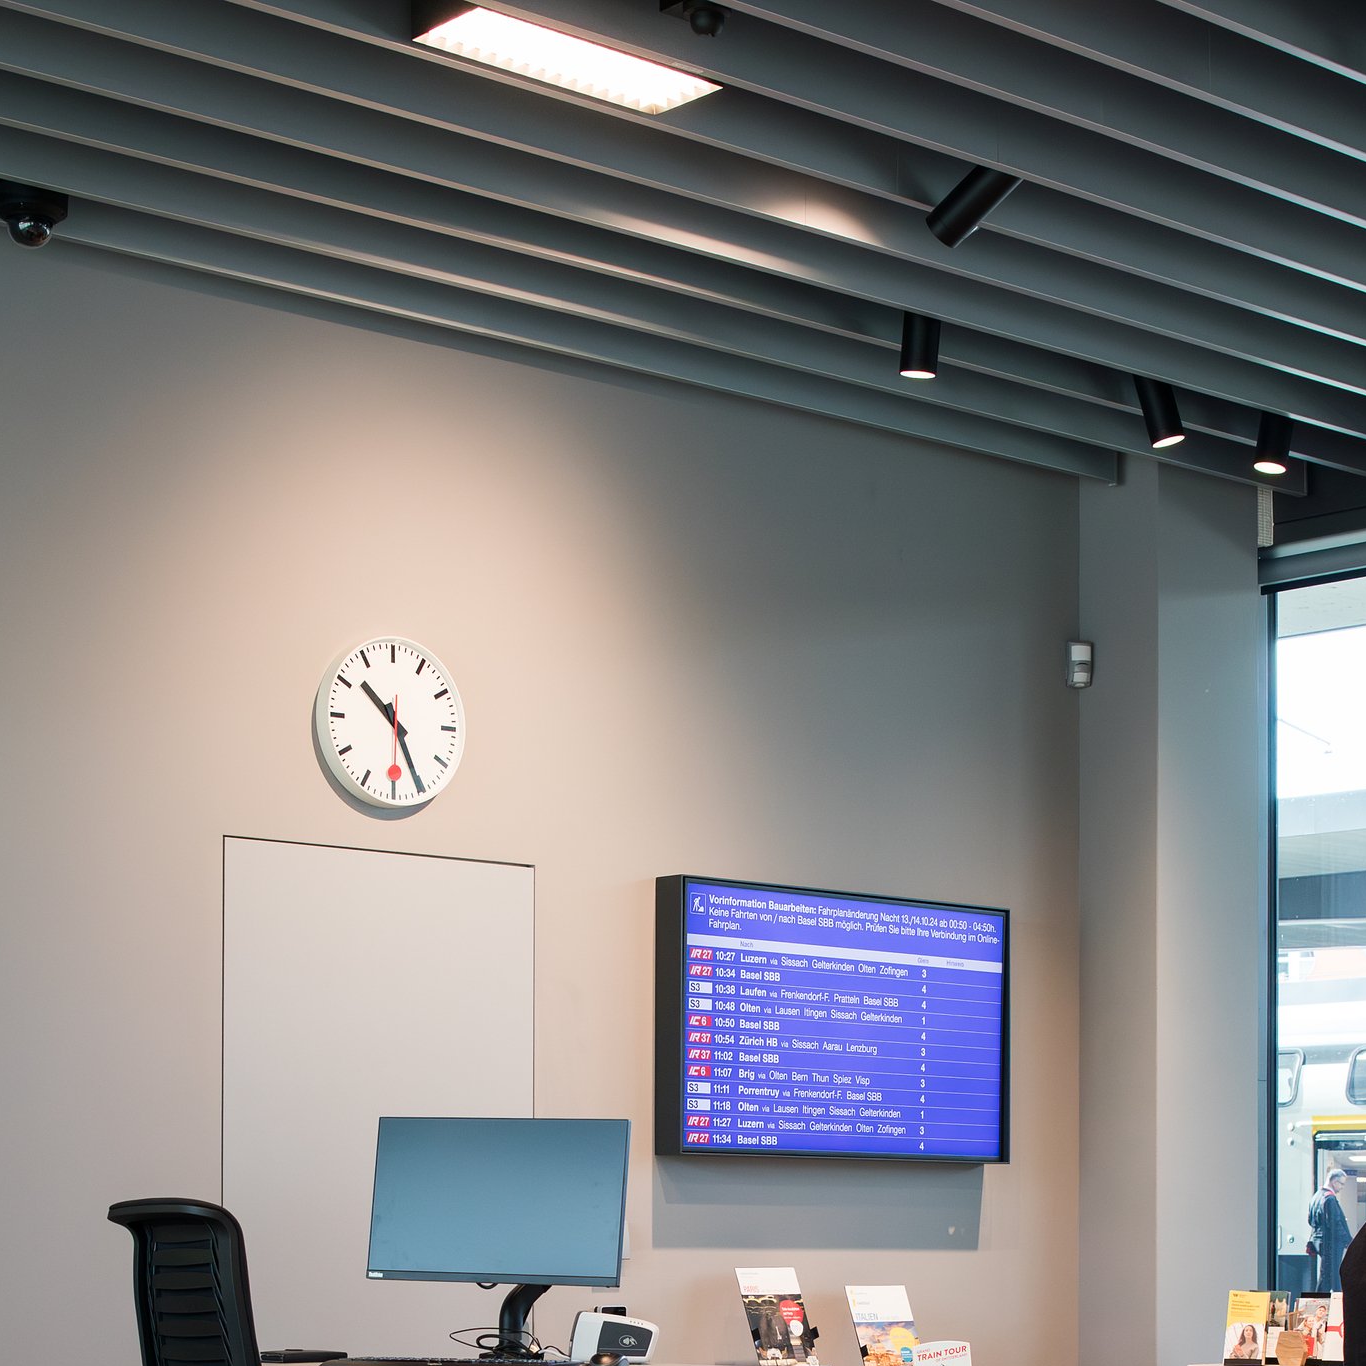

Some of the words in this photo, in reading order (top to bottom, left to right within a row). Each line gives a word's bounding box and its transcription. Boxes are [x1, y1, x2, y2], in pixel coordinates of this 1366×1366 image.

[709, 894, 766, 909] Vorinformation
[768, 900, 816, 914] Bauarbeiten:
[818, 906, 878, 922] Fahrplanänderung
[880, 912, 899, 922] Nacht
[939, 918, 947, 927] ab
[949, 919, 967, 929] 00:50
[972, 922, 996, 932] 04:50h.
[708, 919, 741, 932] Fahrplan.
[709, 906, 728, 917] Keine
[731, 909, 757, 920] Fahrten
[759, 913, 771, 921] von
[778, 913, 795, 923] nach
[797, 915, 816, 926] Basel
[818, 917, 833, 927] SBB
[835, 919, 863, 932] möglich.
[865, 922, 887, 932] Prüfen
[889, 924, 899, 934] Sie
[901, 926, 915, 935] bitte
[916, 927, 929, 937] Ihre
[930, 929, 966, 942] Verbindung
[968, 932, 975, 941] im
[977, 933, 999, 943] Online-
[715, 951, 735, 961] 10:27
[740, 953, 766, 964] Luzern
[781, 956, 808, 967] Sissach
[811, 959, 854, 971] Gelterkinden
[858, 963, 875, 973] Olten
[879, 965, 908, 978] Zofingen
[921, 969, 926, 978] 3
[715, 967, 735, 978] 10:34
[740, 969, 761, 980] Basel
[763, 971, 780, 981] SBB
[921, 985, 926, 993] 4
[690, 982, 700, 992] S3
[715, 984, 735, 994] 10:38
[740, 986, 766, 997] Laufen
[780, 989, 829, 1002] Frenkendorf-F.
[833, 993, 859, 1004] Pratteln
[863, 996, 881, 1006] Basel
[883, 997, 898, 1007] SBB
[921, 1000, 926, 1009] 4
[690, 999, 700, 1009] S3
[714, 1001, 735, 1011] 10:48
[739, 1003, 760, 1013] Olten
[775, 1005, 800, 1016] Lausen
[803, 1007, 826, 1020] Itingen
[830, 1009, 857, 1020] Sissach
[860, 1011, 902, 1023] Gelterkinden
[921, 1016, 925, 1025] 1
[714, 1017, 735, 1028] 10:50
[739, 1019, 760, 1029] Basel
[763, 1021, 779, 1031] SBB
[920, 1032, 925, 1040] 4
[714, 1034, 734, 1044] 10:54
[739, 1036, 763, 1046] Zürich
[766, 1037, 777, 1047] HB
[791, 1039, 818, 1049] Sissach
[822, 1041, 842, 1051] Aarau
[846, 1043, 877, 1055] Lenzburg
[920, 1047, 925, 1056] 3
[714, 1051, 732, 1061] 11:02
[739, 1052, 760, 1062] Basel
[762, 1054, 779, 1063] SBB
[920, 1063, 925, 1072] 4
[713, 1067, 732, 1077] 11:07
[738, 1069, 754, 1080] Brig
[769, 1070, 787, 1080] Olten
[791, 1072, 807, 1081] Bern
[812, 1073, 829, 1082] Thun
[833, 1074, 851, 1086] Spiez
[855, 1075, 870, 1086] Visp
[920, 1079, 924, 1087] 3
[688, 1083, 698, 1092] S3
[713, 1084, 729, 1094] 11:11
[738, 1085, 779, 1098] Porrentruy
[793, 1088, 842, 1099] Frenkendorf-F.
[846, 1091, 865, 1100] Basel
[866, 1092, 881, 1101] SBB
[919, 1094, 924, 1103] 4
[688, 1099, 698, 1109] S3
[713, 1101, 730, 1110] 11:18
[738, 1102, 758, 1112] Olten
[773, 1103, 798, 1113] Lausen
[802, 1105, 825, 1116] Itingen
[829, 1106, 855, 1116] Sissach
[859, 1107, 900, 1118] Gelterkinden
[713, 1117, 731, 1127] 11:27
[737, 1118, 764, 1128] Luzern
[778, 1120, 805, 1130] Sissach
[809, 1121, 852, 1132] Gelterkinden
[855, 1123, 873, 1132] Olten
[877, 1124, 906, 1136] Zofingen
[919, 1126, 924, 1134] 3
[712, 1134, 731, 1143] 11:34
[737, 1135, 758, 1144] Basel
[761, 1136, 777, 1145] SBB
[919, 1142, 924, 1150] 4
[917, 1350, 942, 1362] TRAIN
[944, 1345, 967, 1356] TOUR
